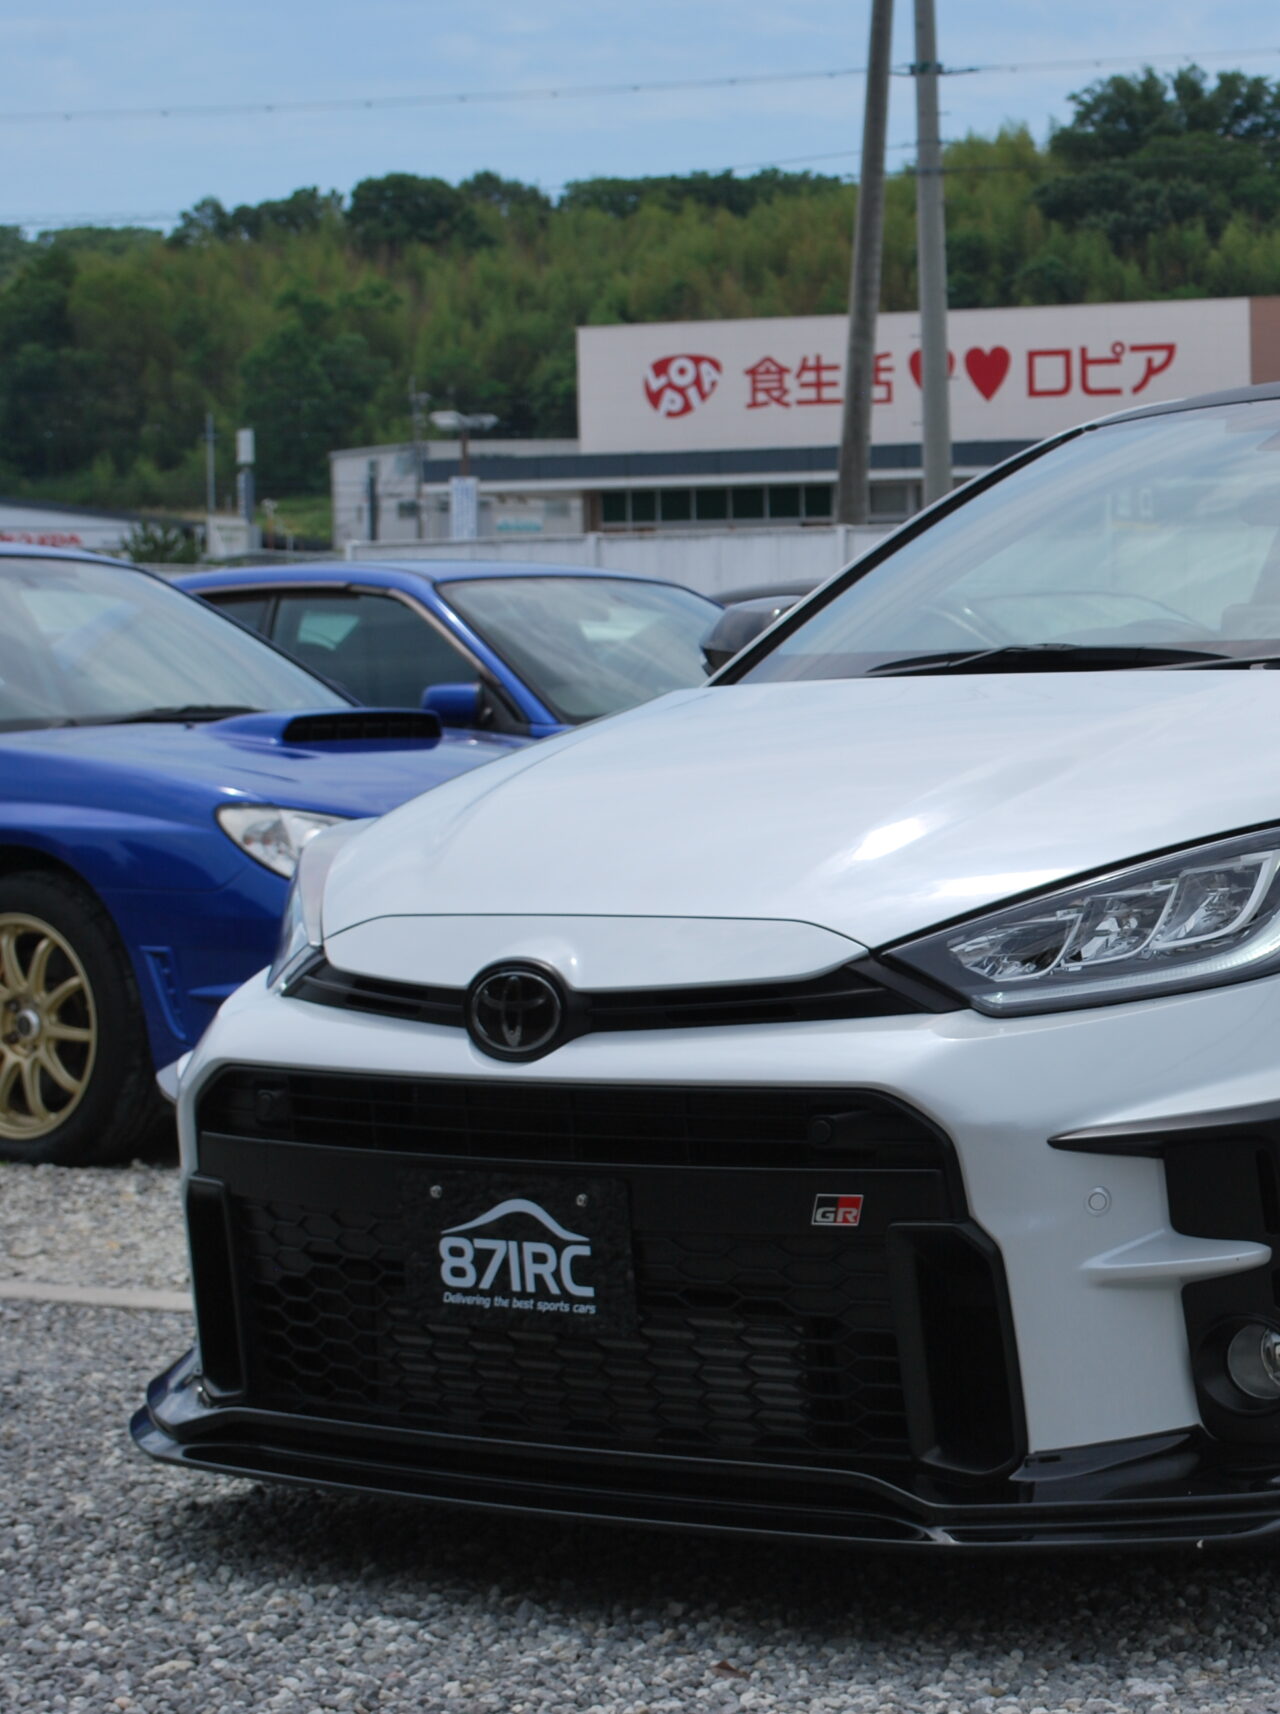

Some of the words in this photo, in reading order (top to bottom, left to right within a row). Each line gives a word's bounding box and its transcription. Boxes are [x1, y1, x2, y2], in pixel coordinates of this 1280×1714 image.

[1028, 341, 1177, 398] ロピア
[815, 1207, 859, 1223] GR
[443, 1291, 491, 1309] Delivering
[494, 1296, 509, 1308] the
[512, 1298, 534, 1310] best
[537, 1300, 570, 1313] sports
[573, 1304, 596, 1315] cars
